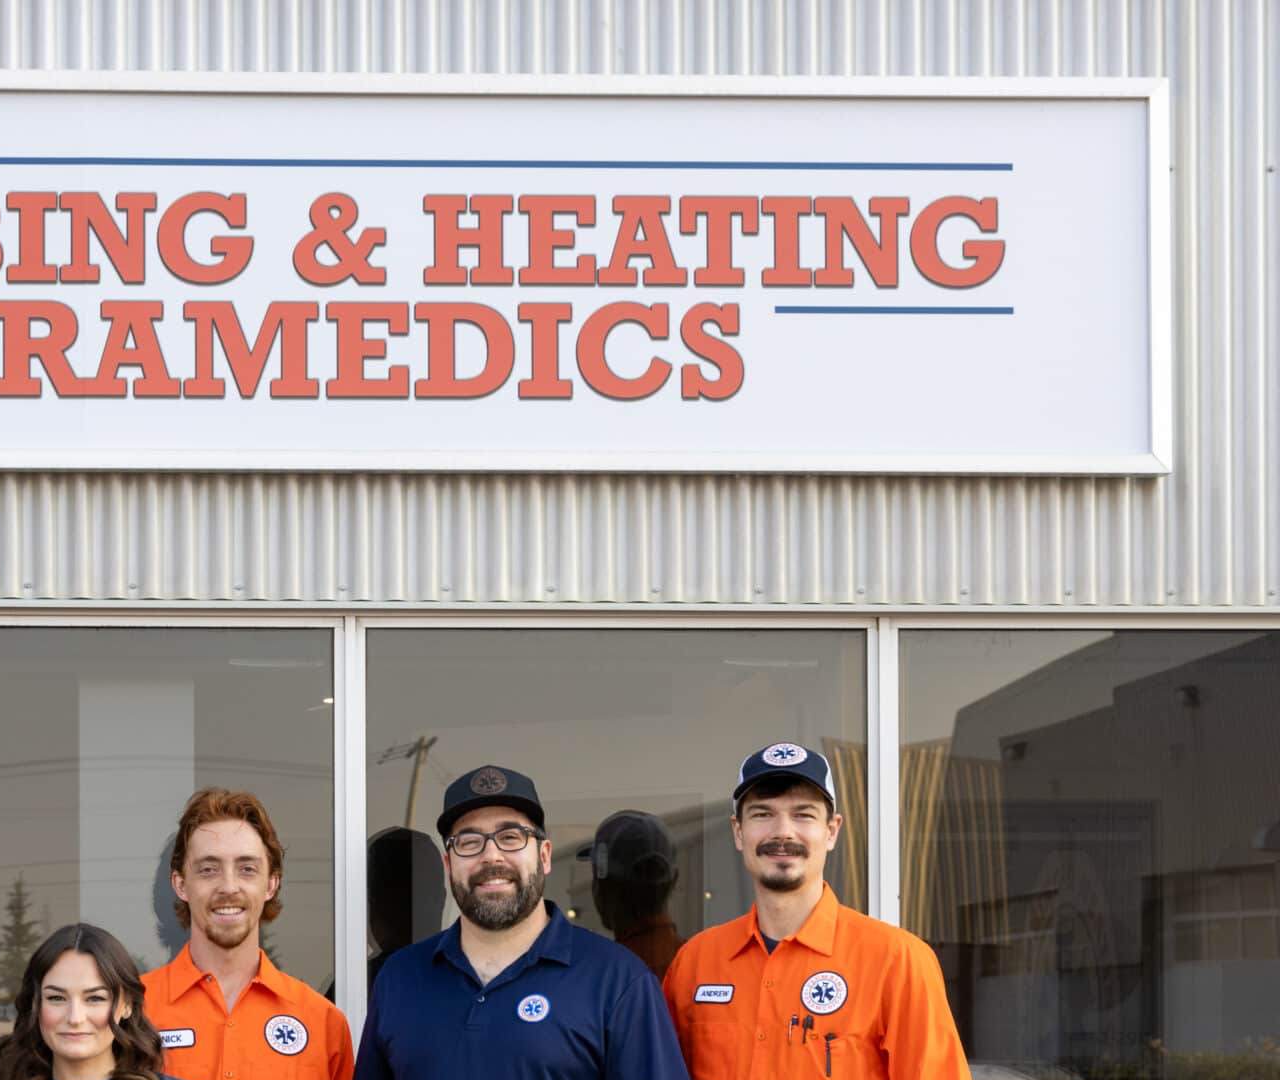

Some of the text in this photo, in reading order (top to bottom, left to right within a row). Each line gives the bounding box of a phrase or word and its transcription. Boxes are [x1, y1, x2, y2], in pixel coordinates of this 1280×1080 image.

[293, 192, 387, 286] &
[422, 194, 1006, 288] HEATING
[700, 989, 729, 998] ANDREW
